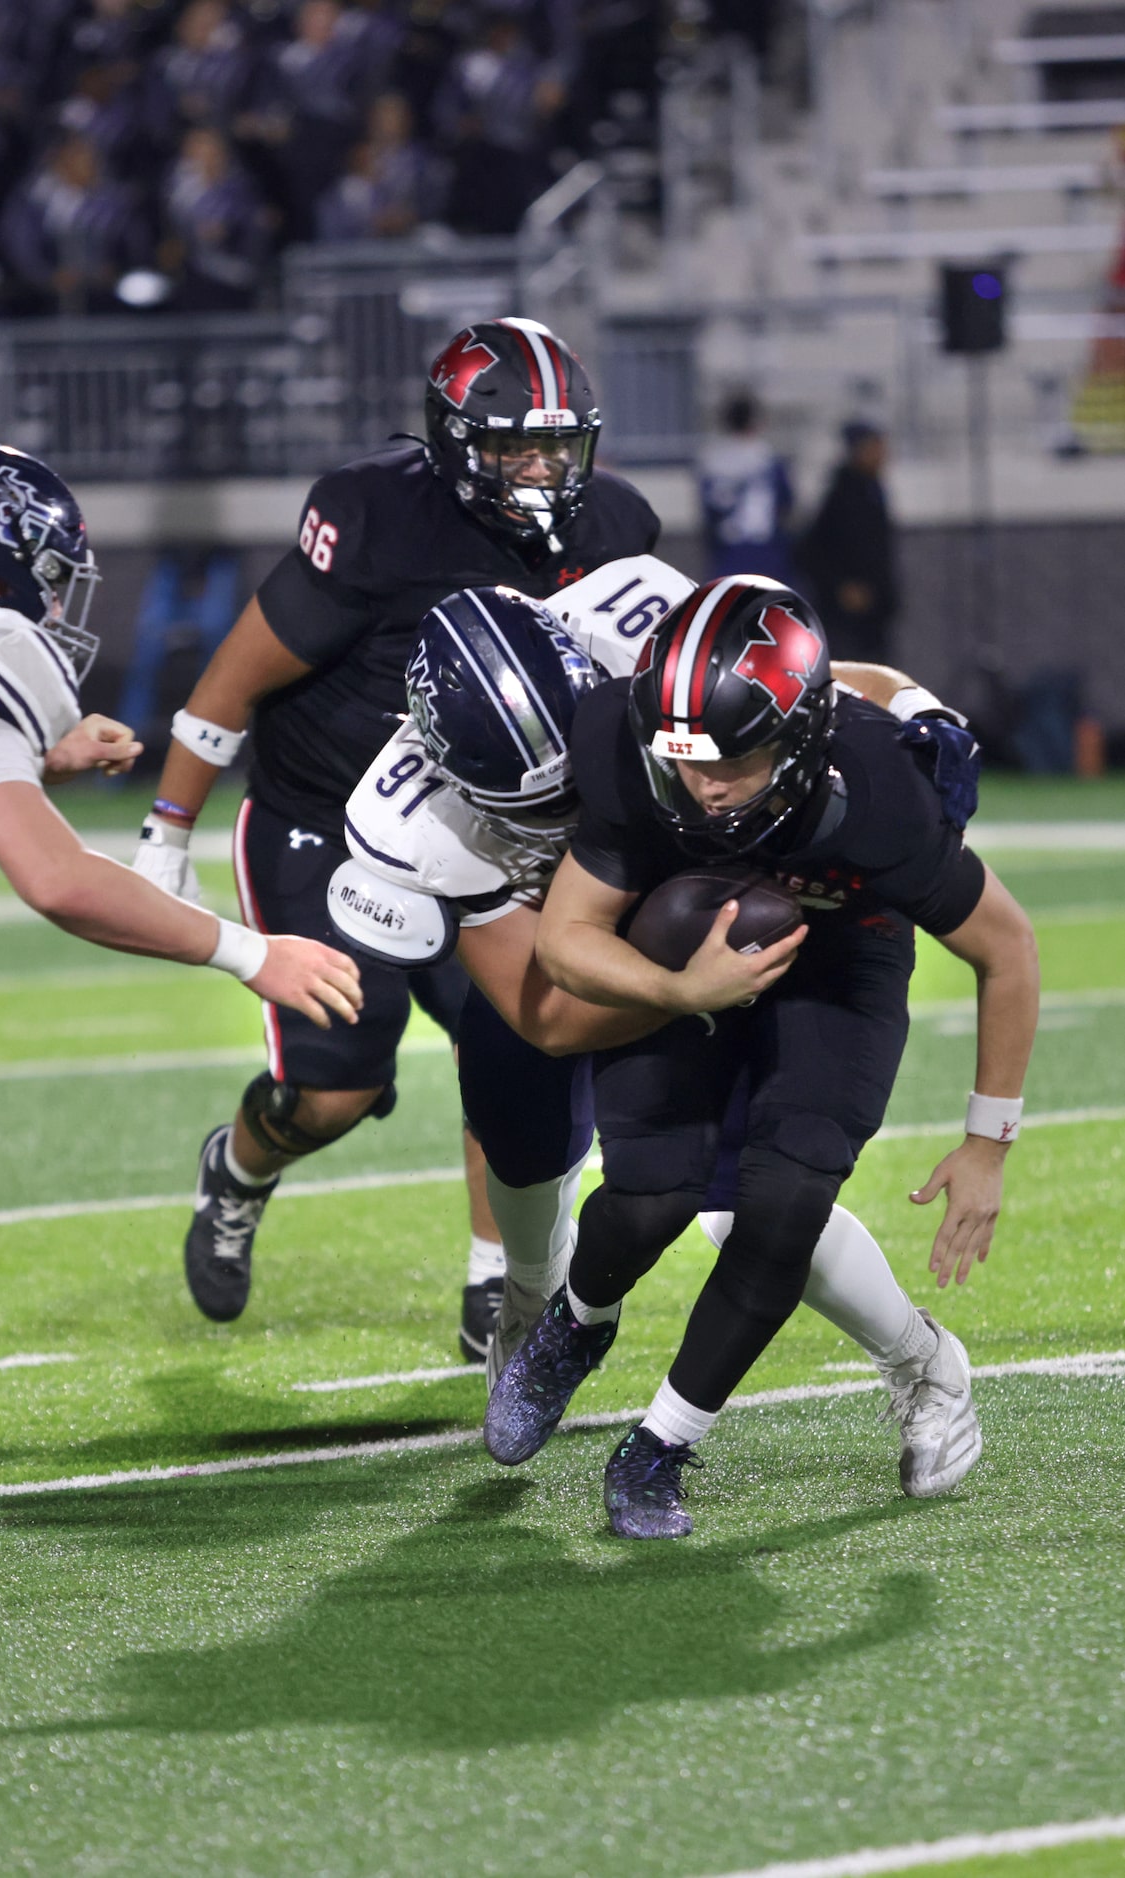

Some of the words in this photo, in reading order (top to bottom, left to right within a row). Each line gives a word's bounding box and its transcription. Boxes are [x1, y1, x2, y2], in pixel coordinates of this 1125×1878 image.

[299, 505, 338, 573] 66
[592, 575, 671, 640] 91
[731, 604, 822, 719] M
[667, 741, 693, 755] BXT
[375, 752, 446, 820] 91
